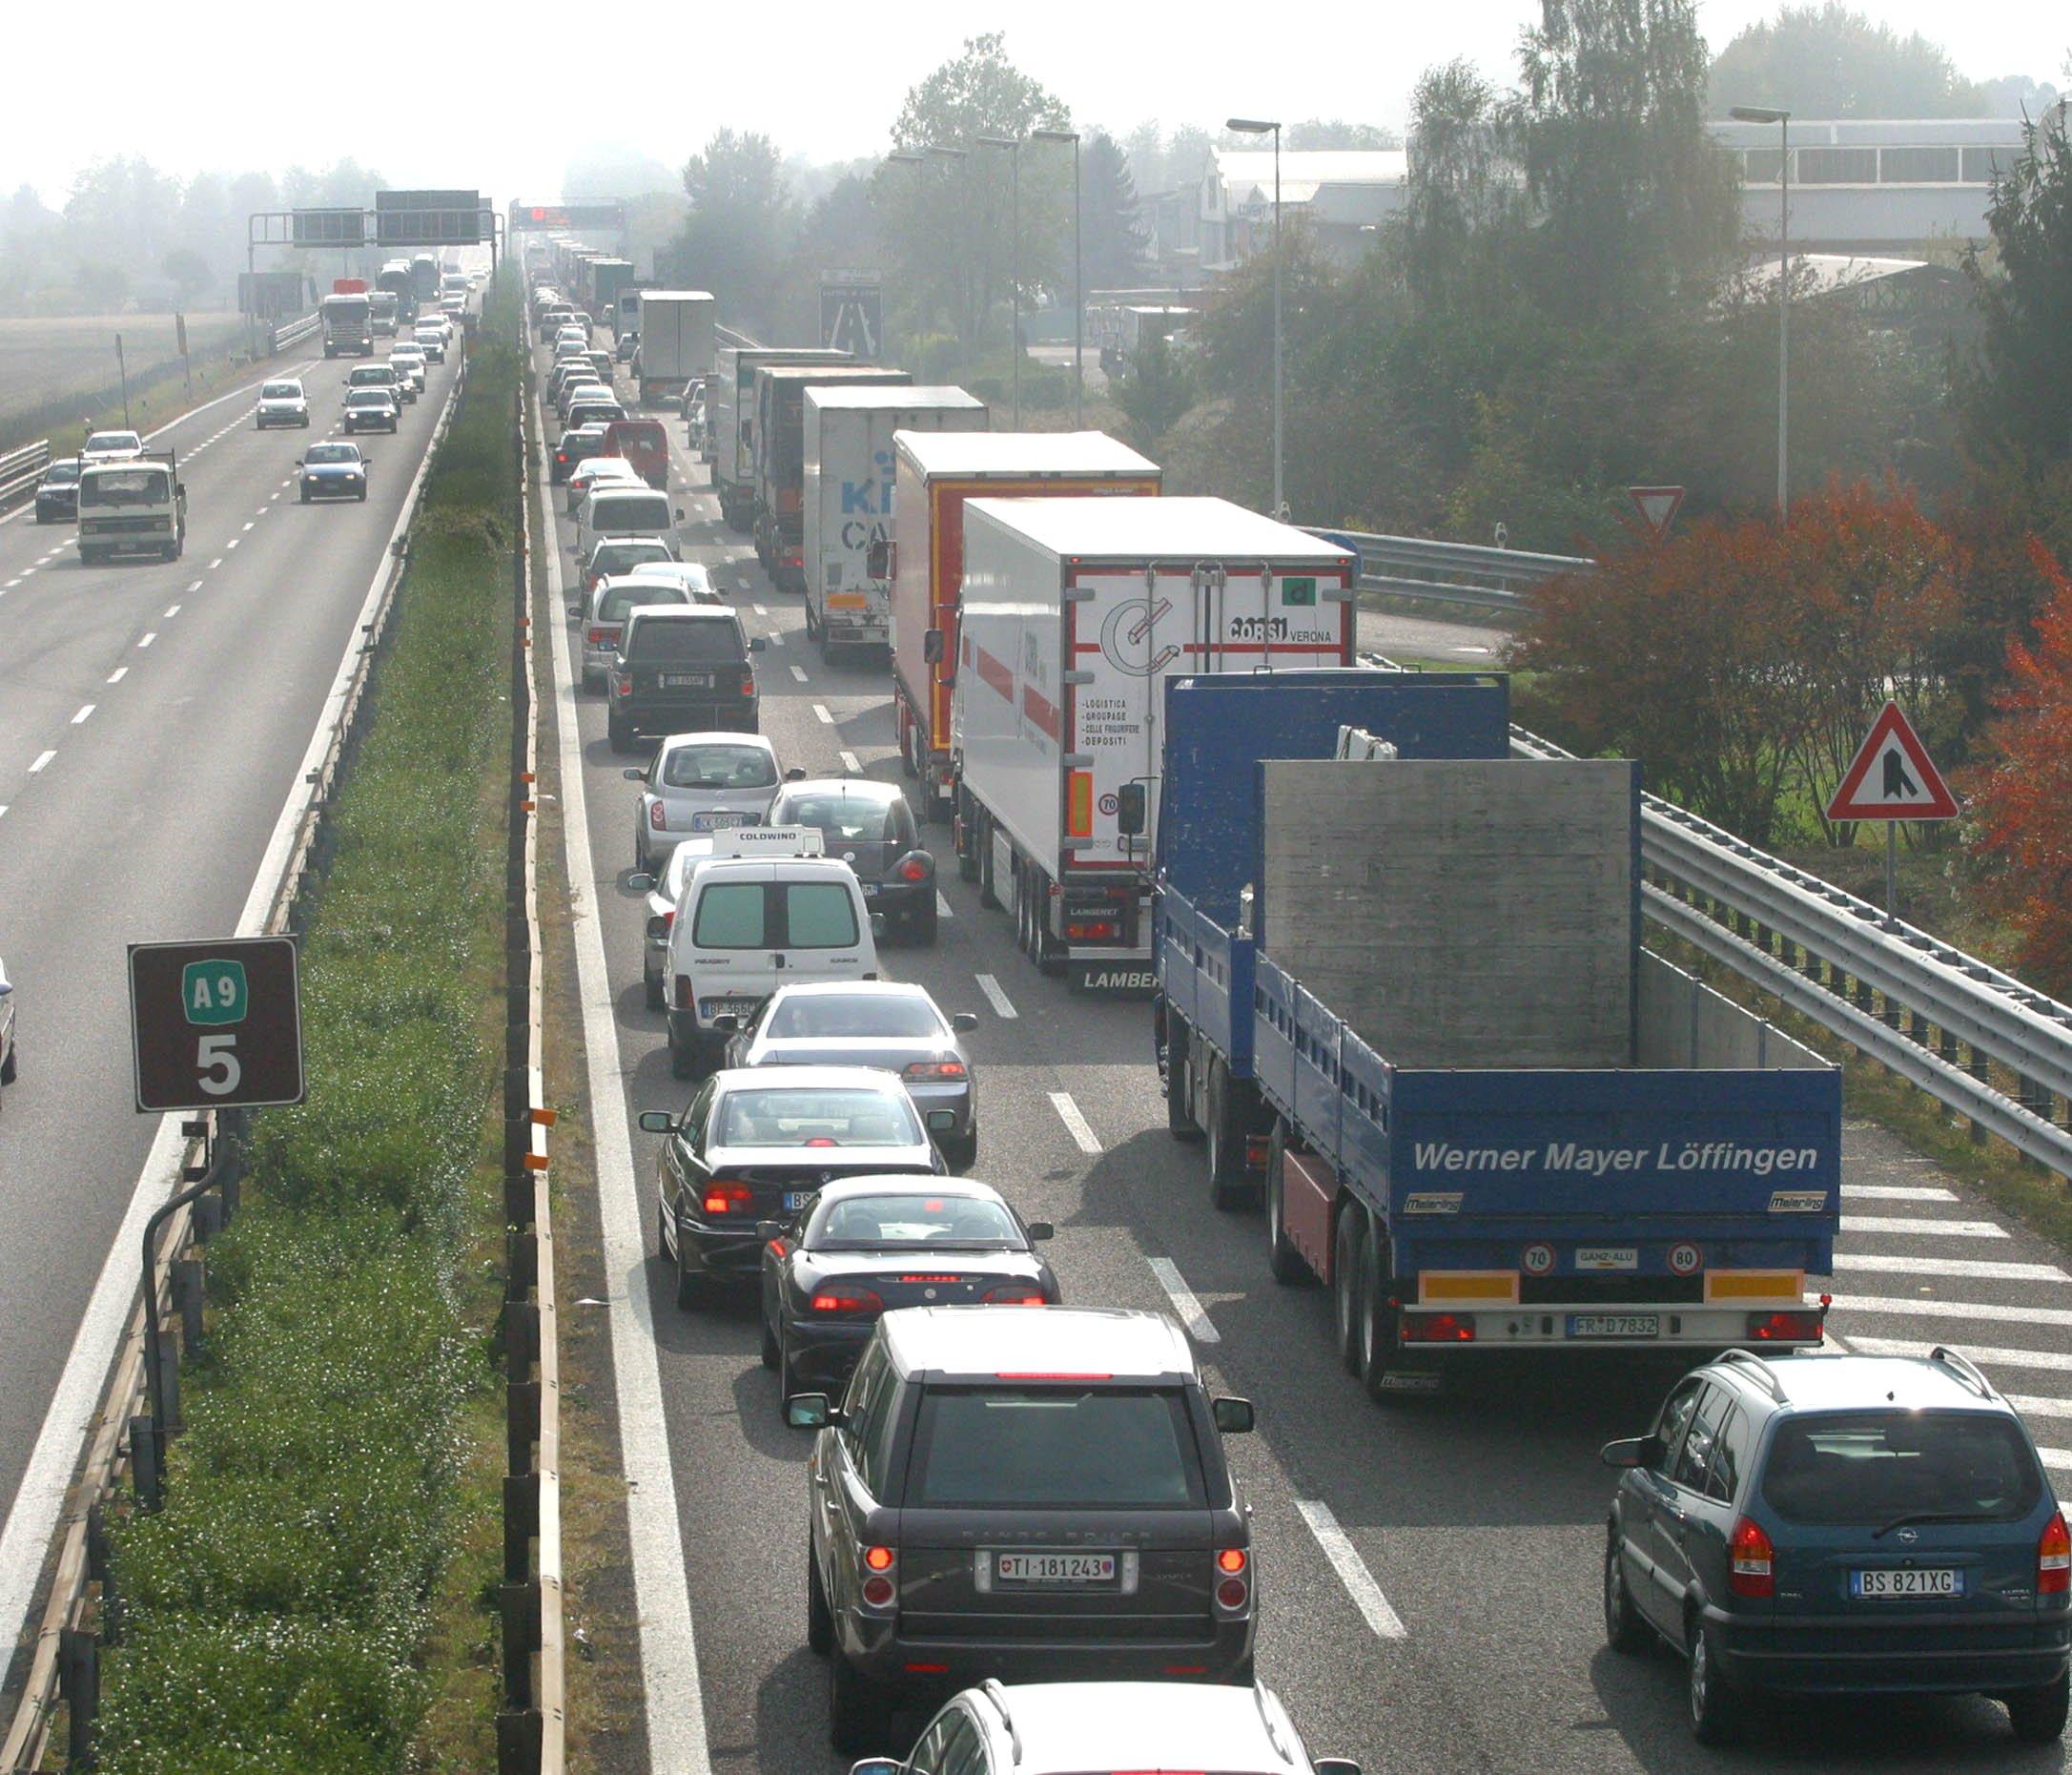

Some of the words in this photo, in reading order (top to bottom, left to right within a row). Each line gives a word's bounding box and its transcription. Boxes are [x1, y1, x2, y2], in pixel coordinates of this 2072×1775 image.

[1228, 616, 1287, 643] CORSI
[1290, 630, 1332, 643] VERONA
[1103, 799, 1116, 810] 70
[739, 832, 797, 841] COLDWIND
[196, 1033, 241, 1096] 5
[1414, 1143, 1537, 1171] Werner
[1543, 1143, 1650, 1177] Mayer
[1656, 1142, 1818, 1176] Löffingen
[1529, 1251, 1547, 1266] 70
[1675, 1250, 1693, 1266] 80
